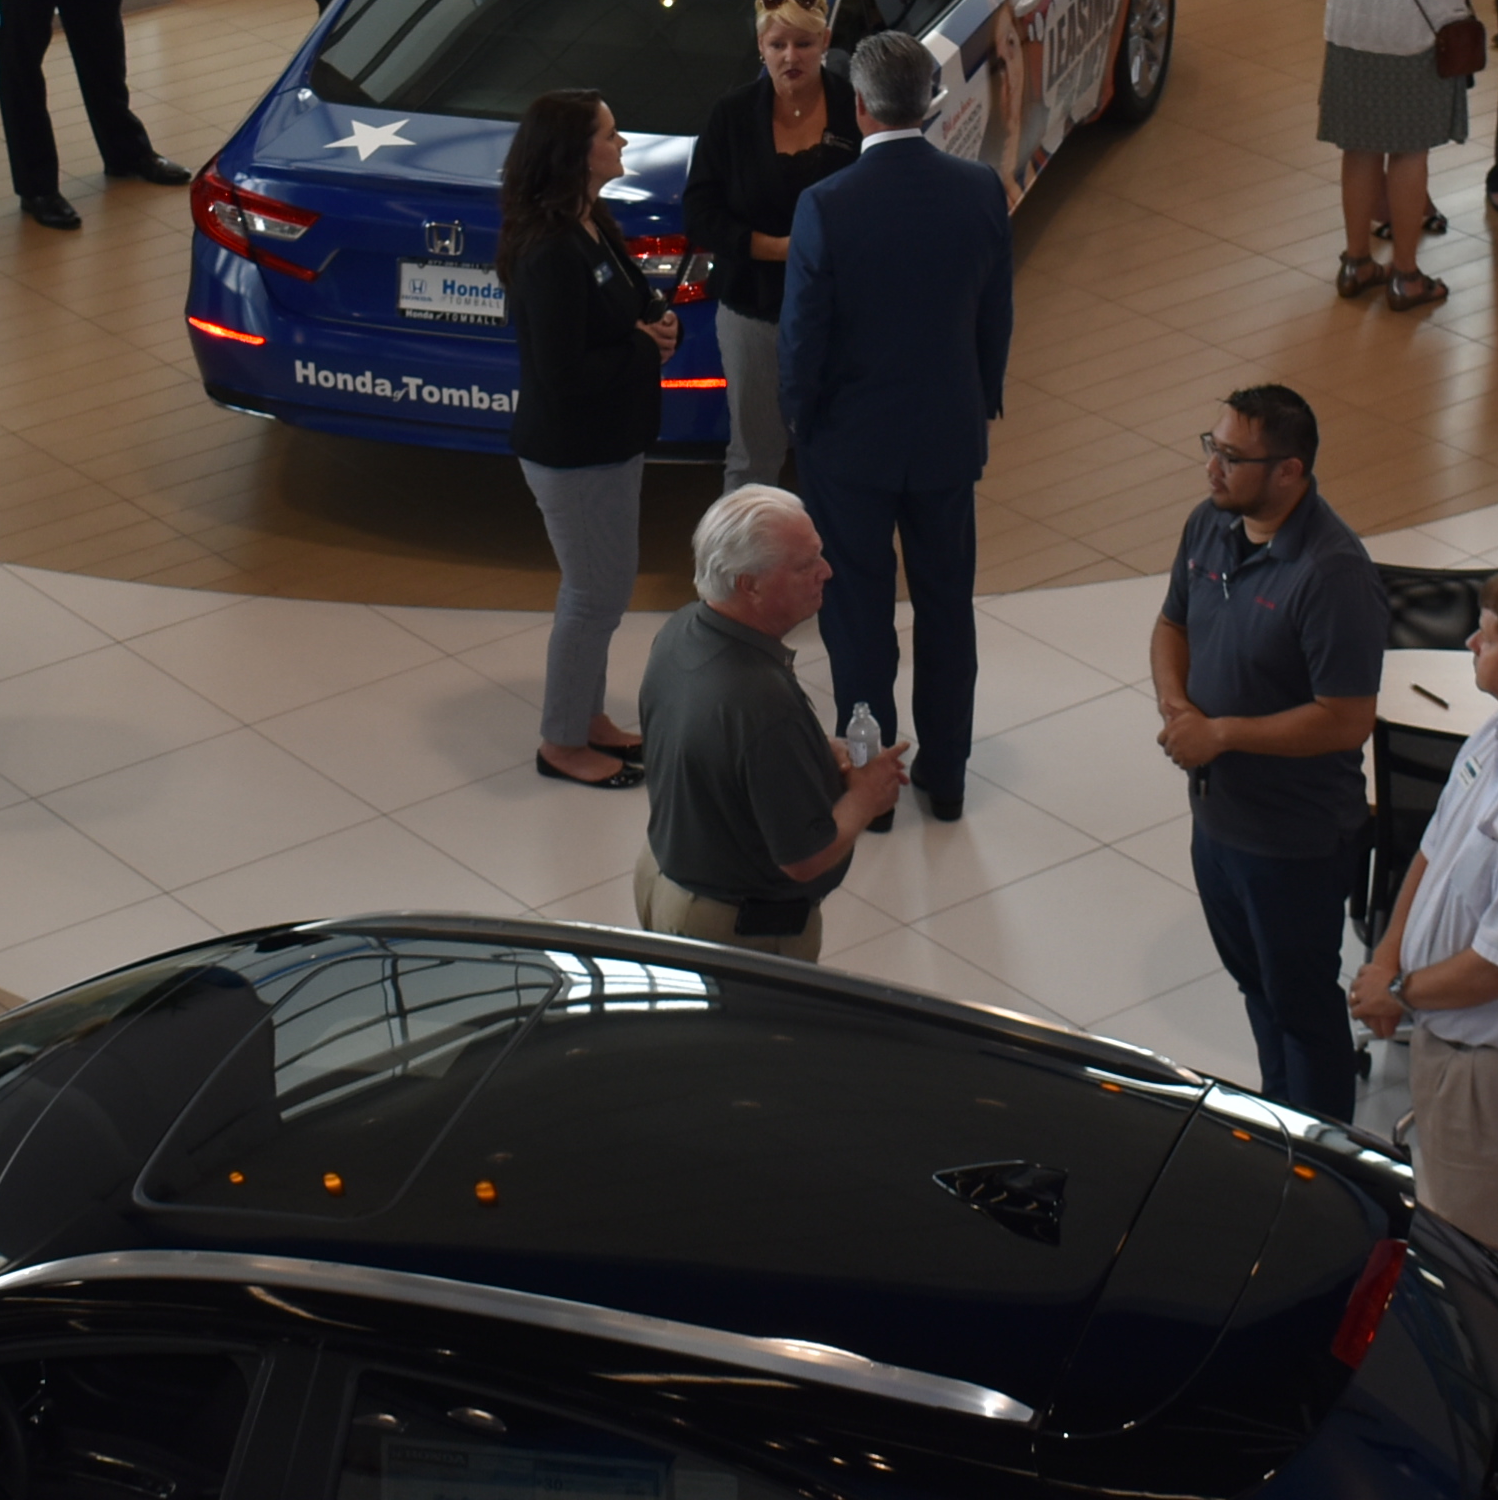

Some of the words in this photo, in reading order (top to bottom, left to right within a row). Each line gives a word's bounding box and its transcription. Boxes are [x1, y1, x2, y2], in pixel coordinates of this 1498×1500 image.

[442, 279, 505, 299] Honda
[449, 297, 501, 309] TOMBALL
[405, 309, 434, 319] Honda
[445, 312, 497, 326] TOMBALL
[295, 360, 392, 397] Honda
